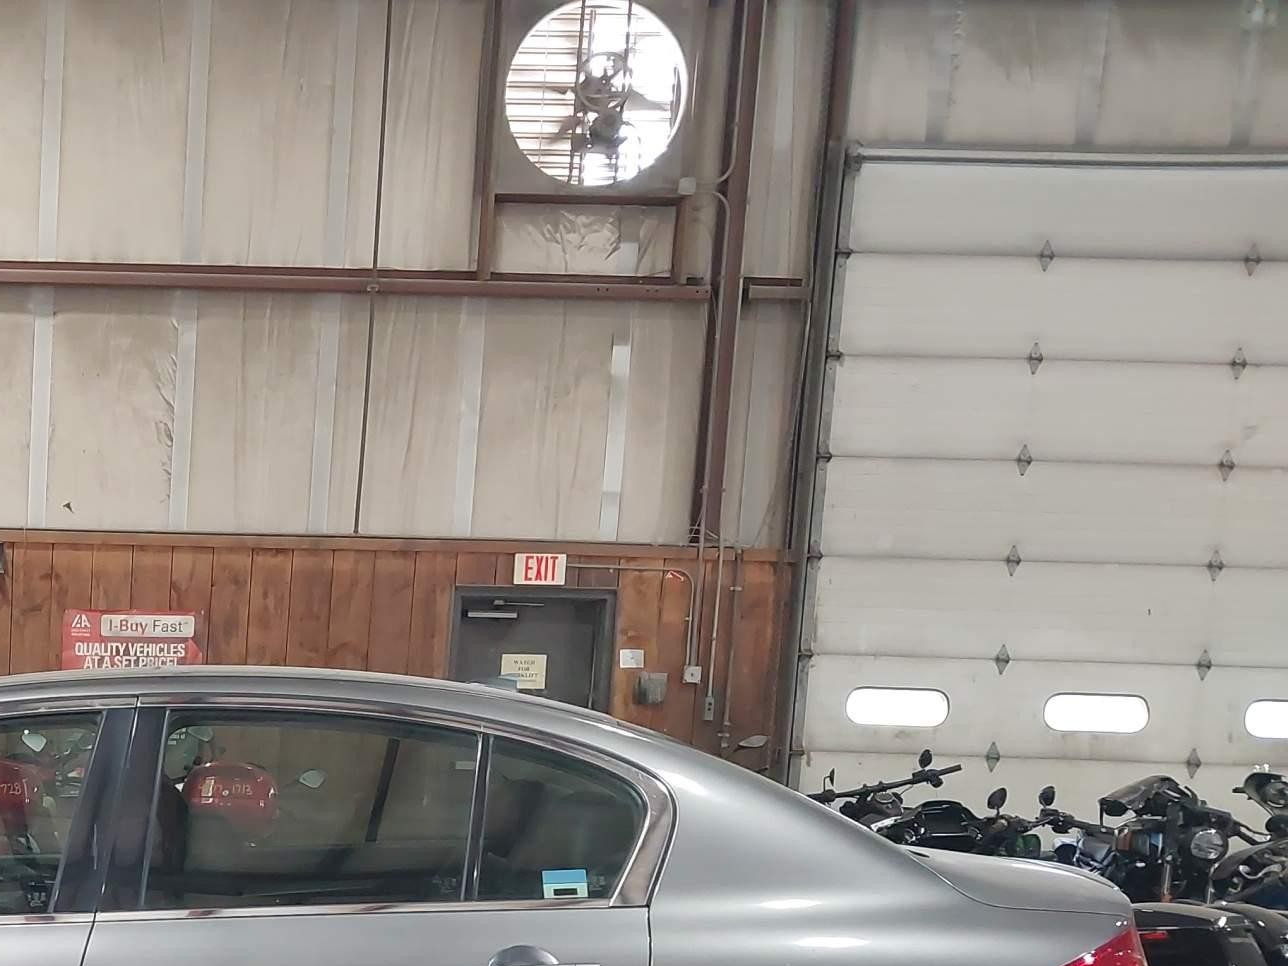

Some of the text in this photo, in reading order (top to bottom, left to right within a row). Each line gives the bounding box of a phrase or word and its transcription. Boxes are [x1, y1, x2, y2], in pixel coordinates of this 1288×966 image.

[524, 555, 558, 581] EXIT
[109, 619, 148, 635] I-Buy
[75, 642, 186, 657] QUALITY VEHICLES
[83, 656, 101, 669] AT
[102, 656, 113, 669] A
